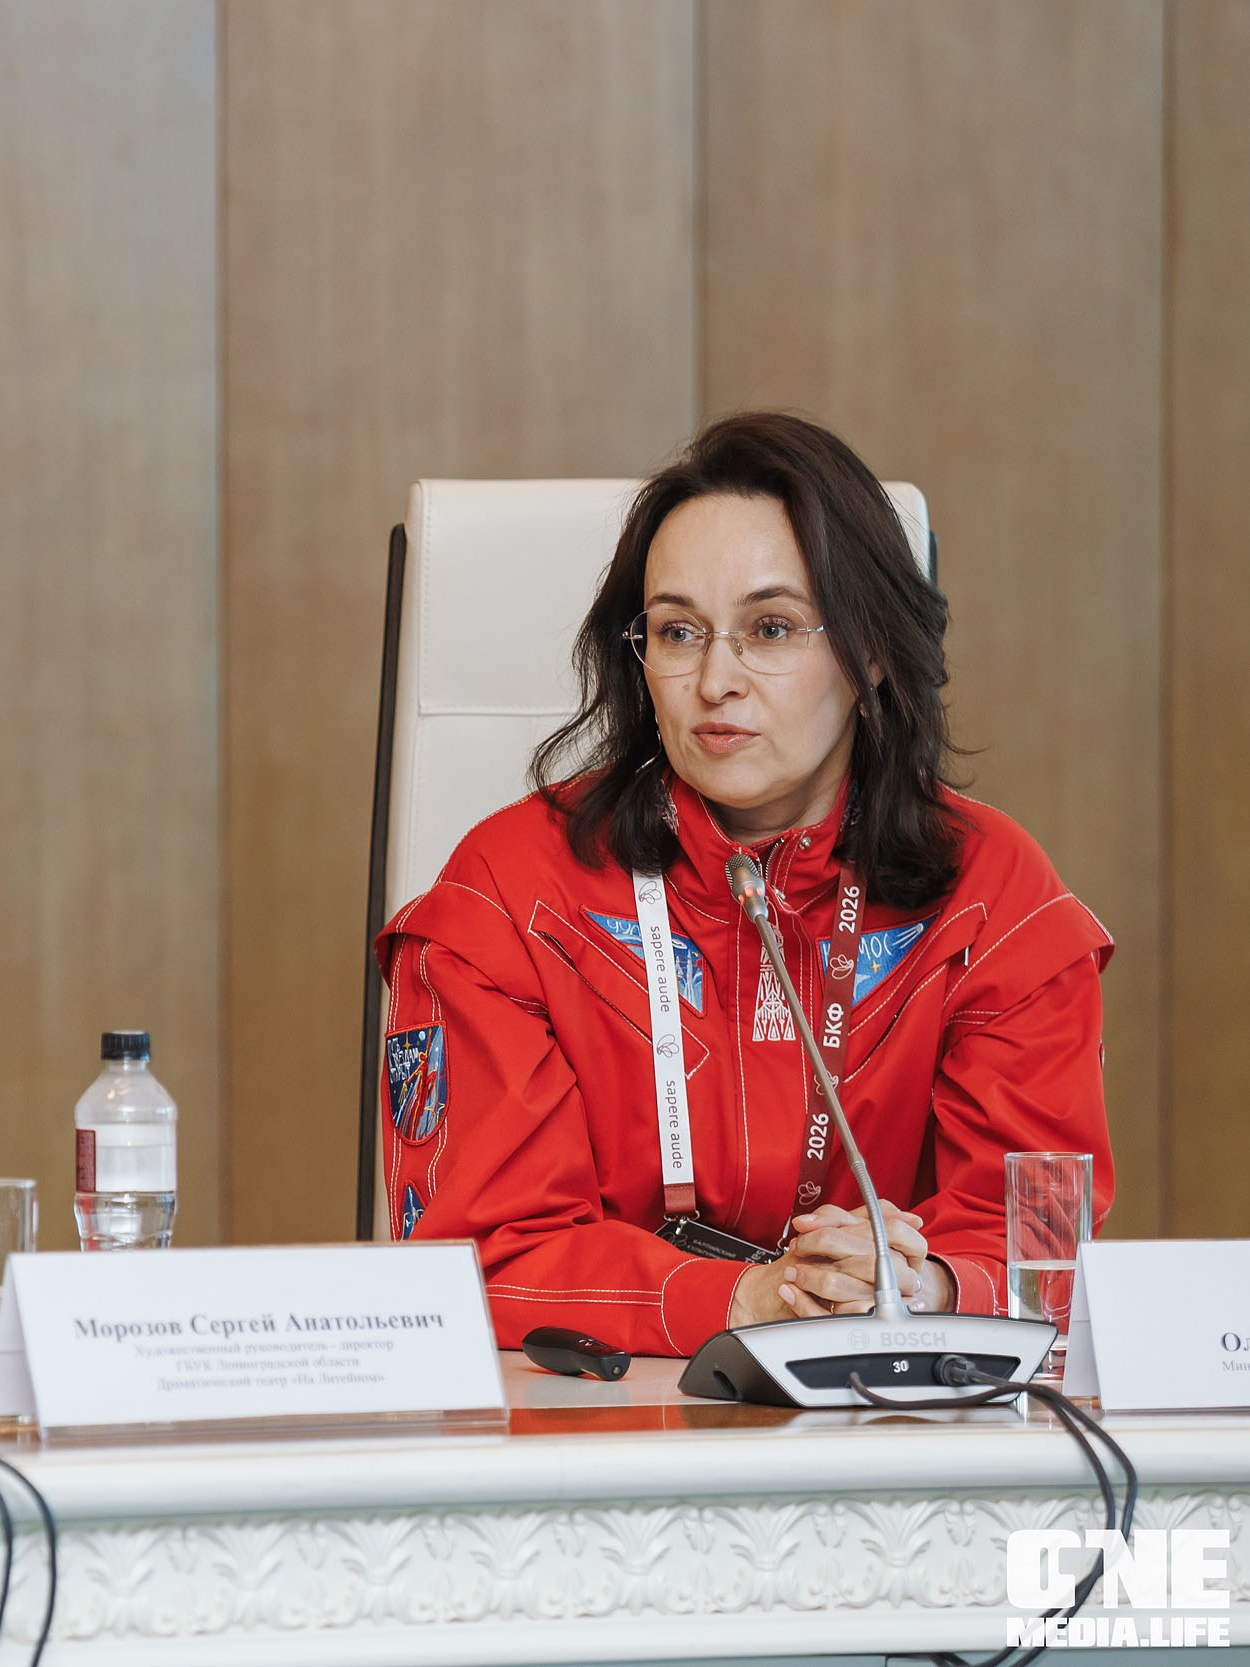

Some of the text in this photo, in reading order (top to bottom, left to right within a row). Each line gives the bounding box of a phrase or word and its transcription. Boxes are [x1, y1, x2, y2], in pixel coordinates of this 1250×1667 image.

[839, 886, 860, 933] 2026
[651, 926, 670, 1013] sapere aude
[823, 1002, 844, 1049] БКФ
[666, 1080, 682, 1169] sapere aude
[807, 1113, 829, 1161] 2026
[73, 1310, 444, 1342] Морозов Сергей Анатольевич
[880, 1332, 947, 1347] BOSCH
[892, 1360, 909, 1373] 30
